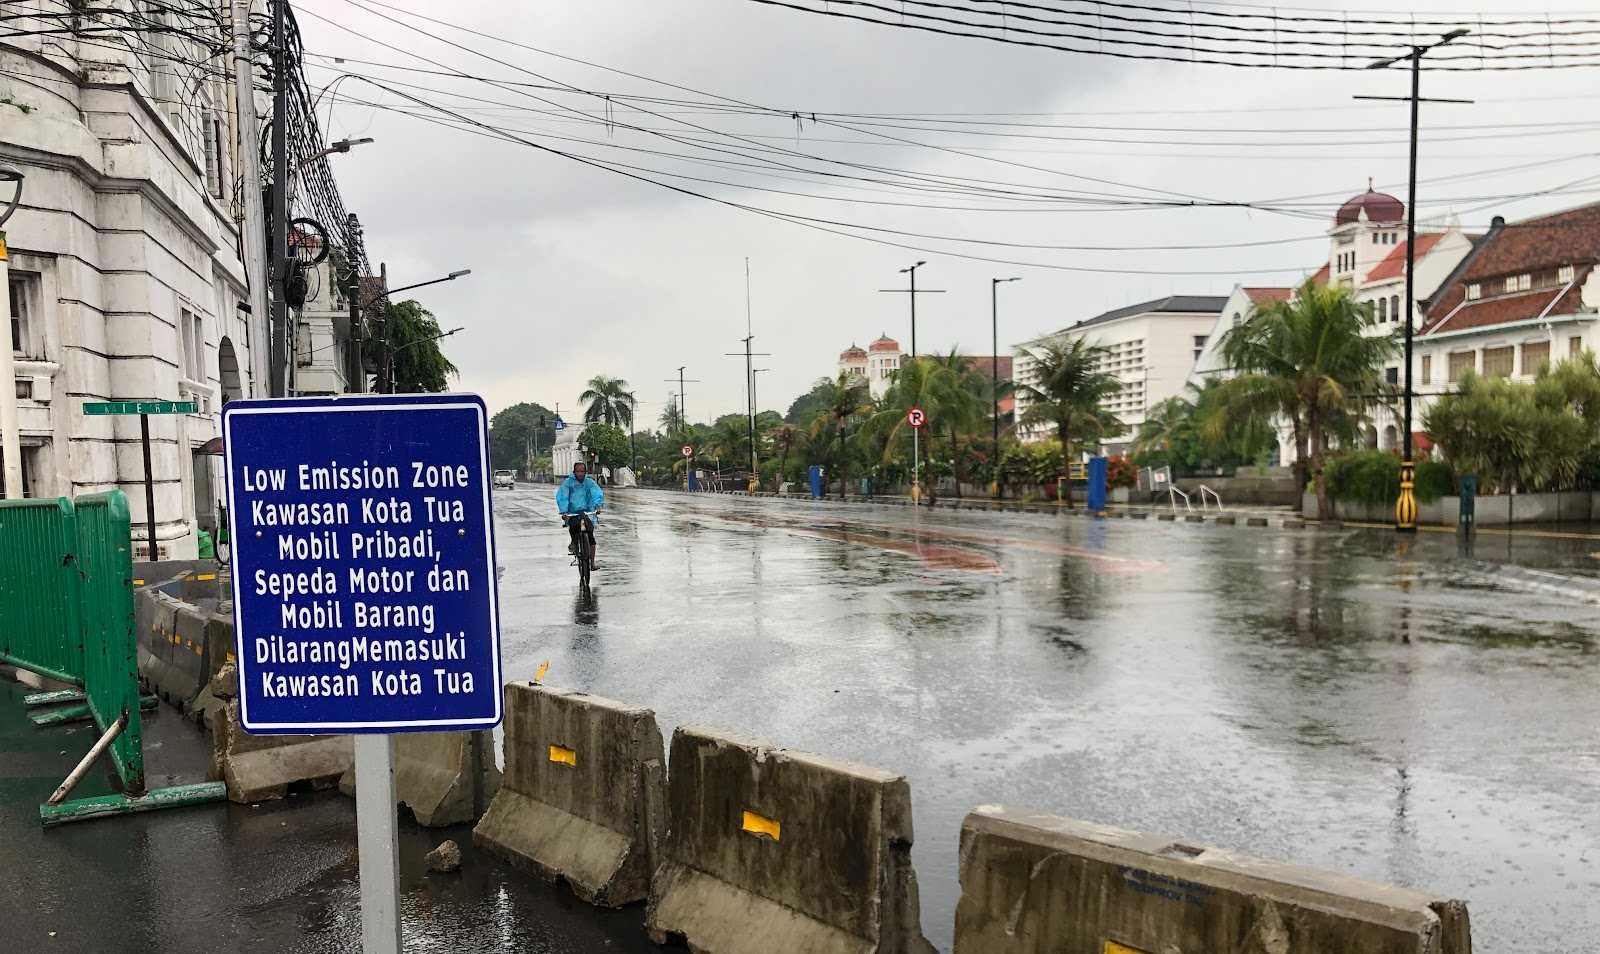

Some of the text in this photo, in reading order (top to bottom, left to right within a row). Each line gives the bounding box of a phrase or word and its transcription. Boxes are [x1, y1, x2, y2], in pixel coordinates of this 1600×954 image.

[242, 460, 469, 492] Low Emission Zone
[252, 496, 465, 526] Kawasan Kota Tua
[278, 528, 441, 562] Mobil Pribadi,
[254, 564, 470, 602] Sepeda Motor dan
[281, 599, 435, 634] Mobil Barang
[262, 667, 474, 698] Kawasan Kota Tua
